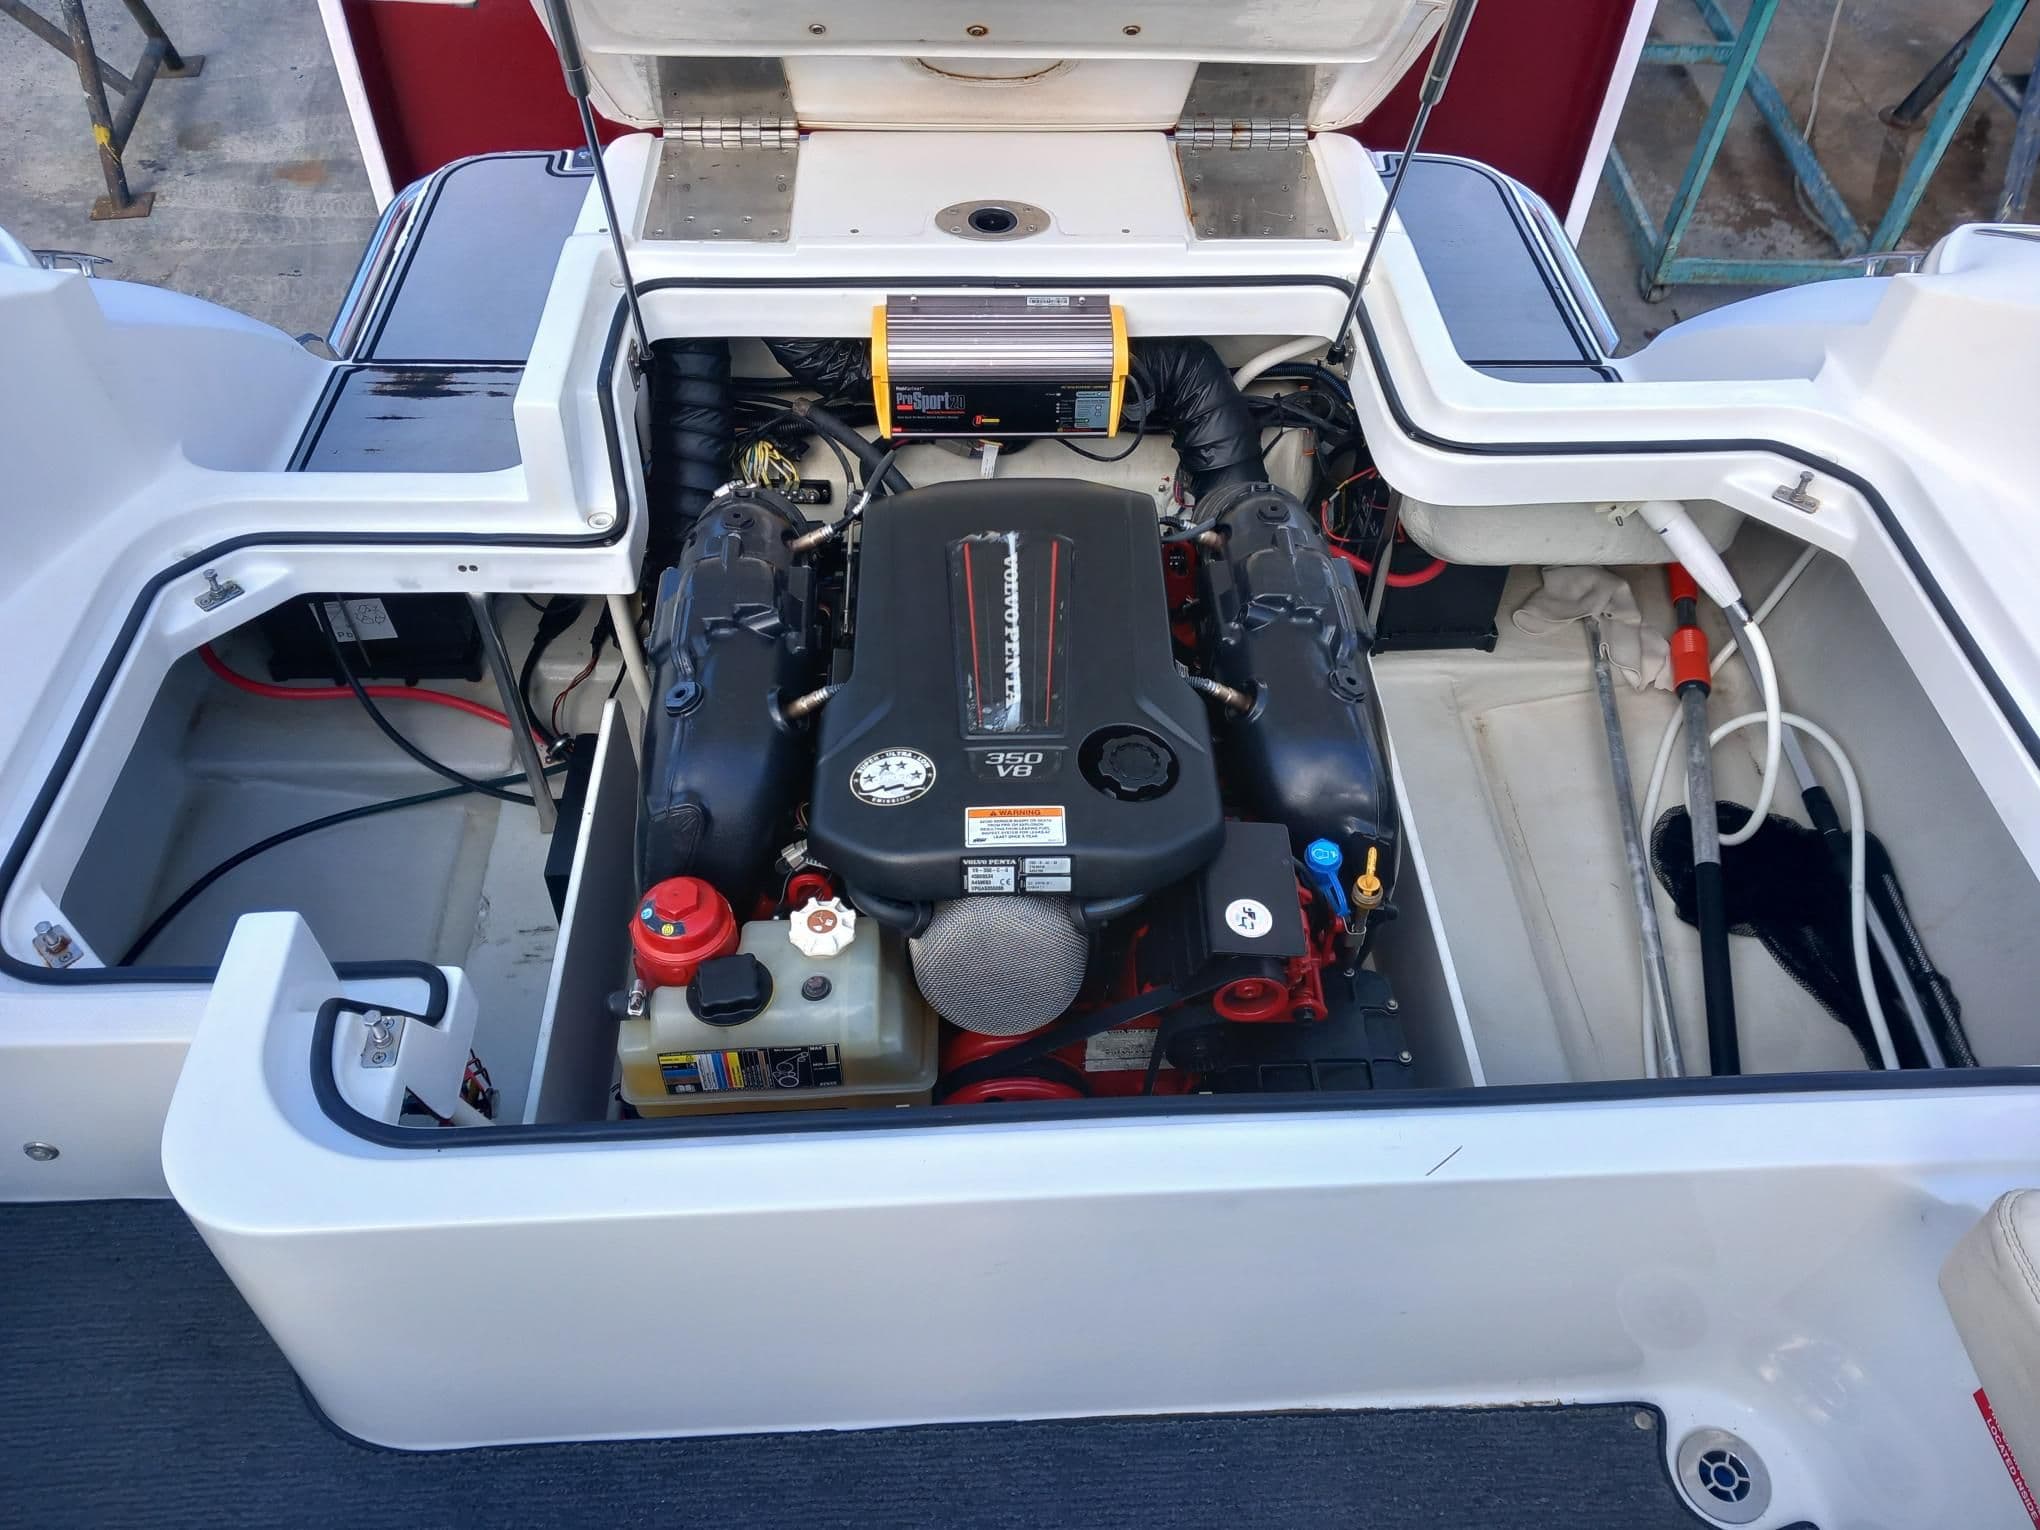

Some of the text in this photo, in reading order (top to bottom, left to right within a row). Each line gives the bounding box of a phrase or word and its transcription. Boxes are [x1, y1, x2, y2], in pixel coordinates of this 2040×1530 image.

[985, 752, 1044, 765] 350
[997, 764, 1033, 778] V8
[999, 808, 1041, 816] WARNING
[1986, 1417, 2018, 1476] LOCATED
[2014, 1477, 2039, 1521] INSIDE
